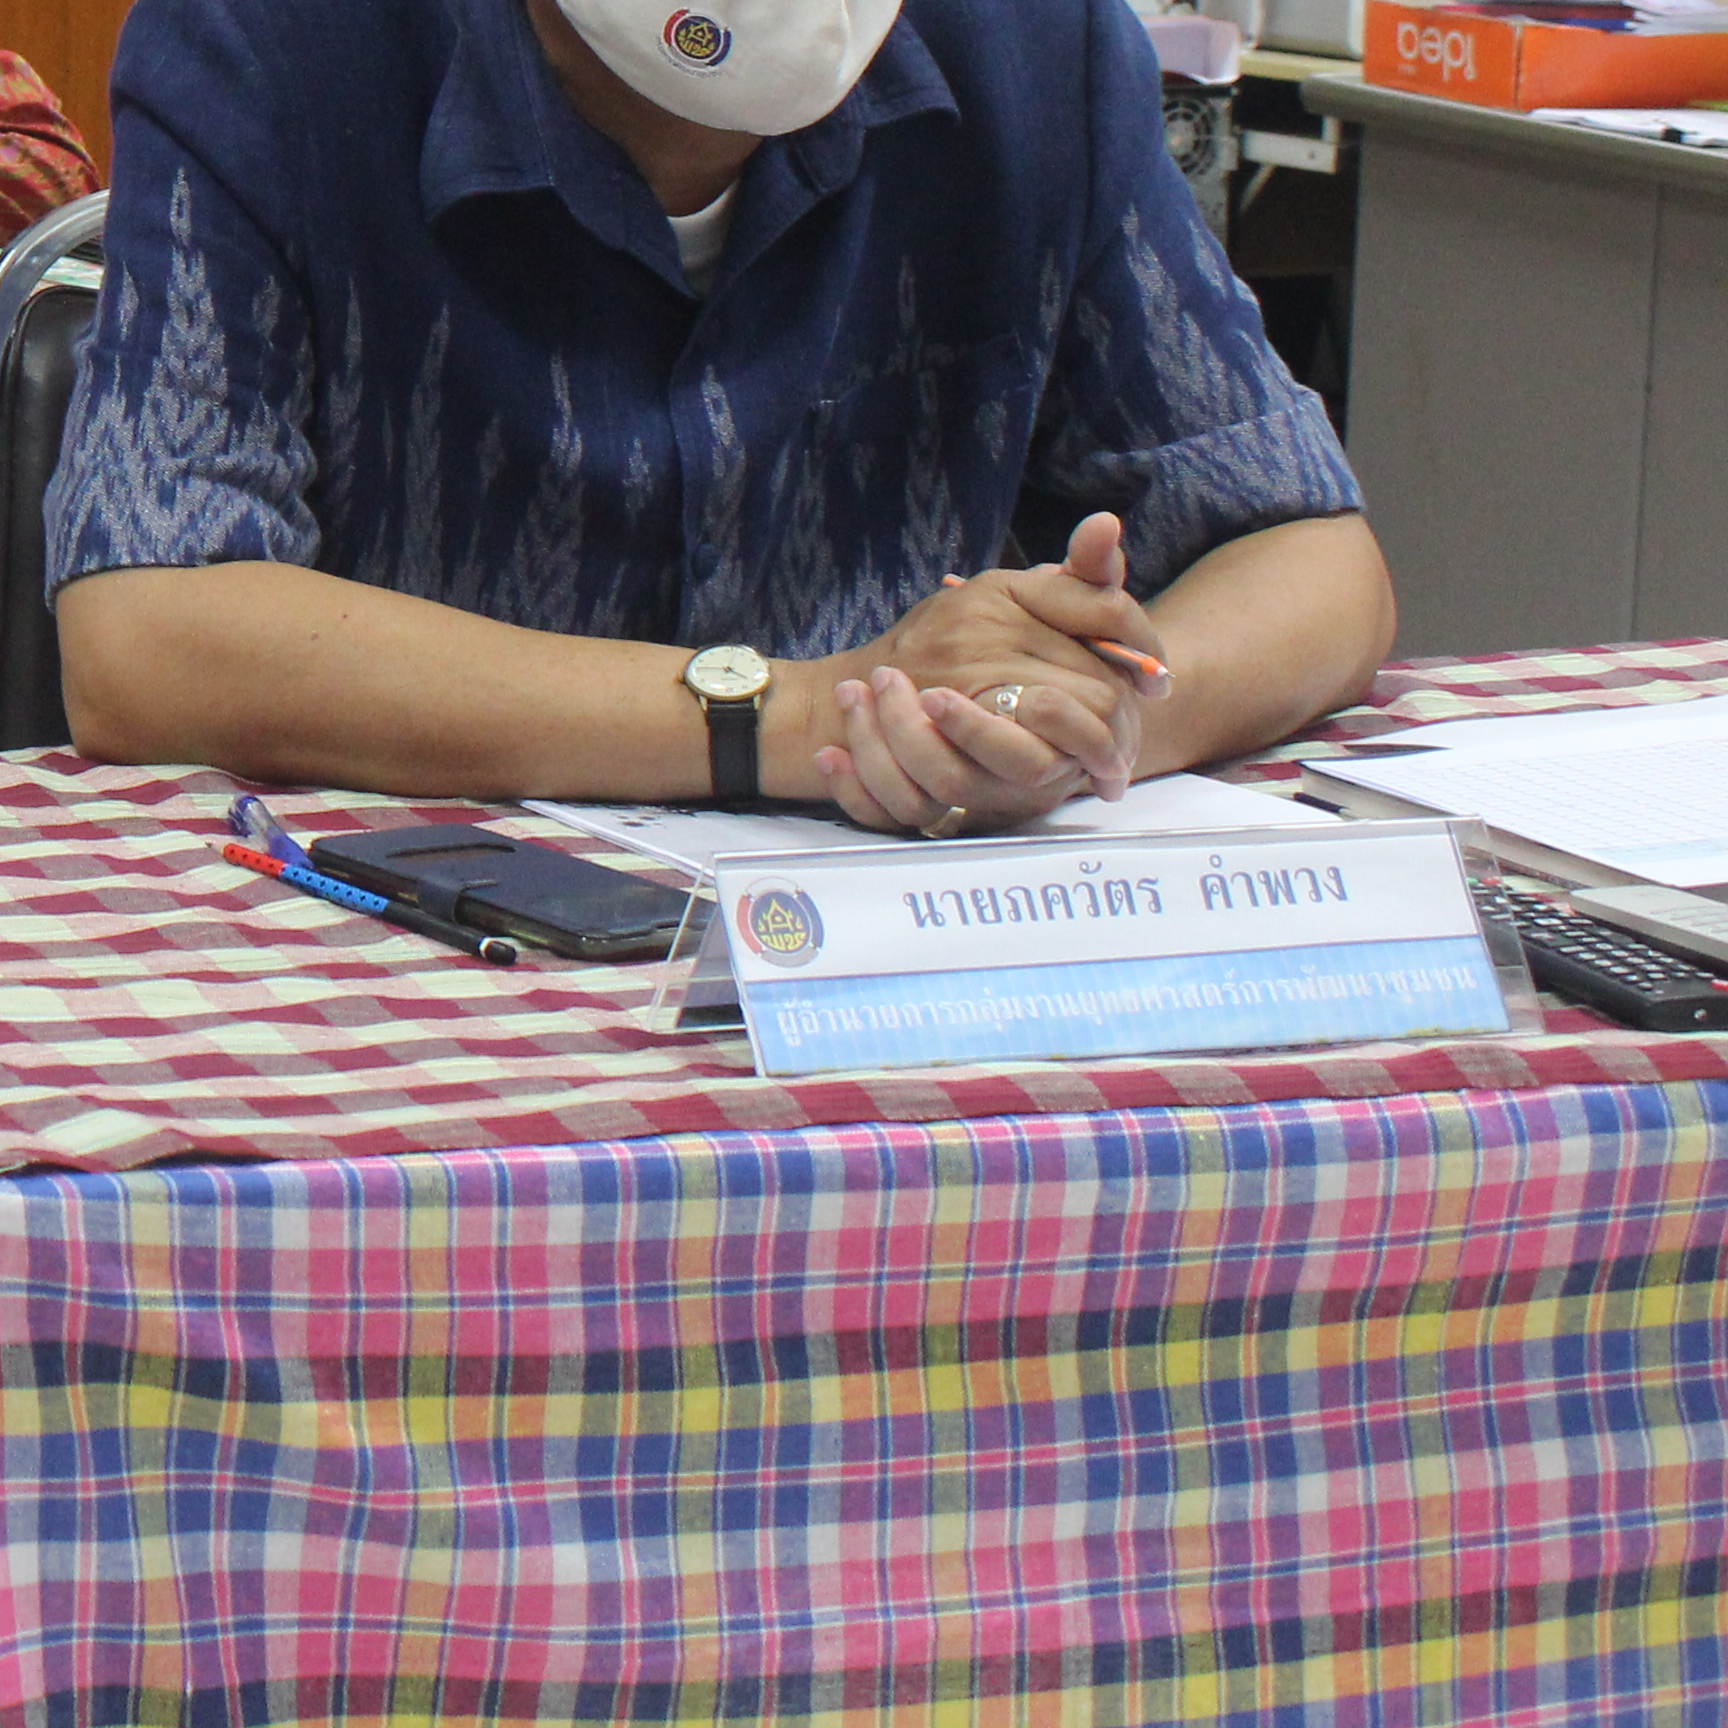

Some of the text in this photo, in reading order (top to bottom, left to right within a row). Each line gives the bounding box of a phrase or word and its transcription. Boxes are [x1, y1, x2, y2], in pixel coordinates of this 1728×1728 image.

[902, 852, 1350, 929] นายภควัตร คำพวง
